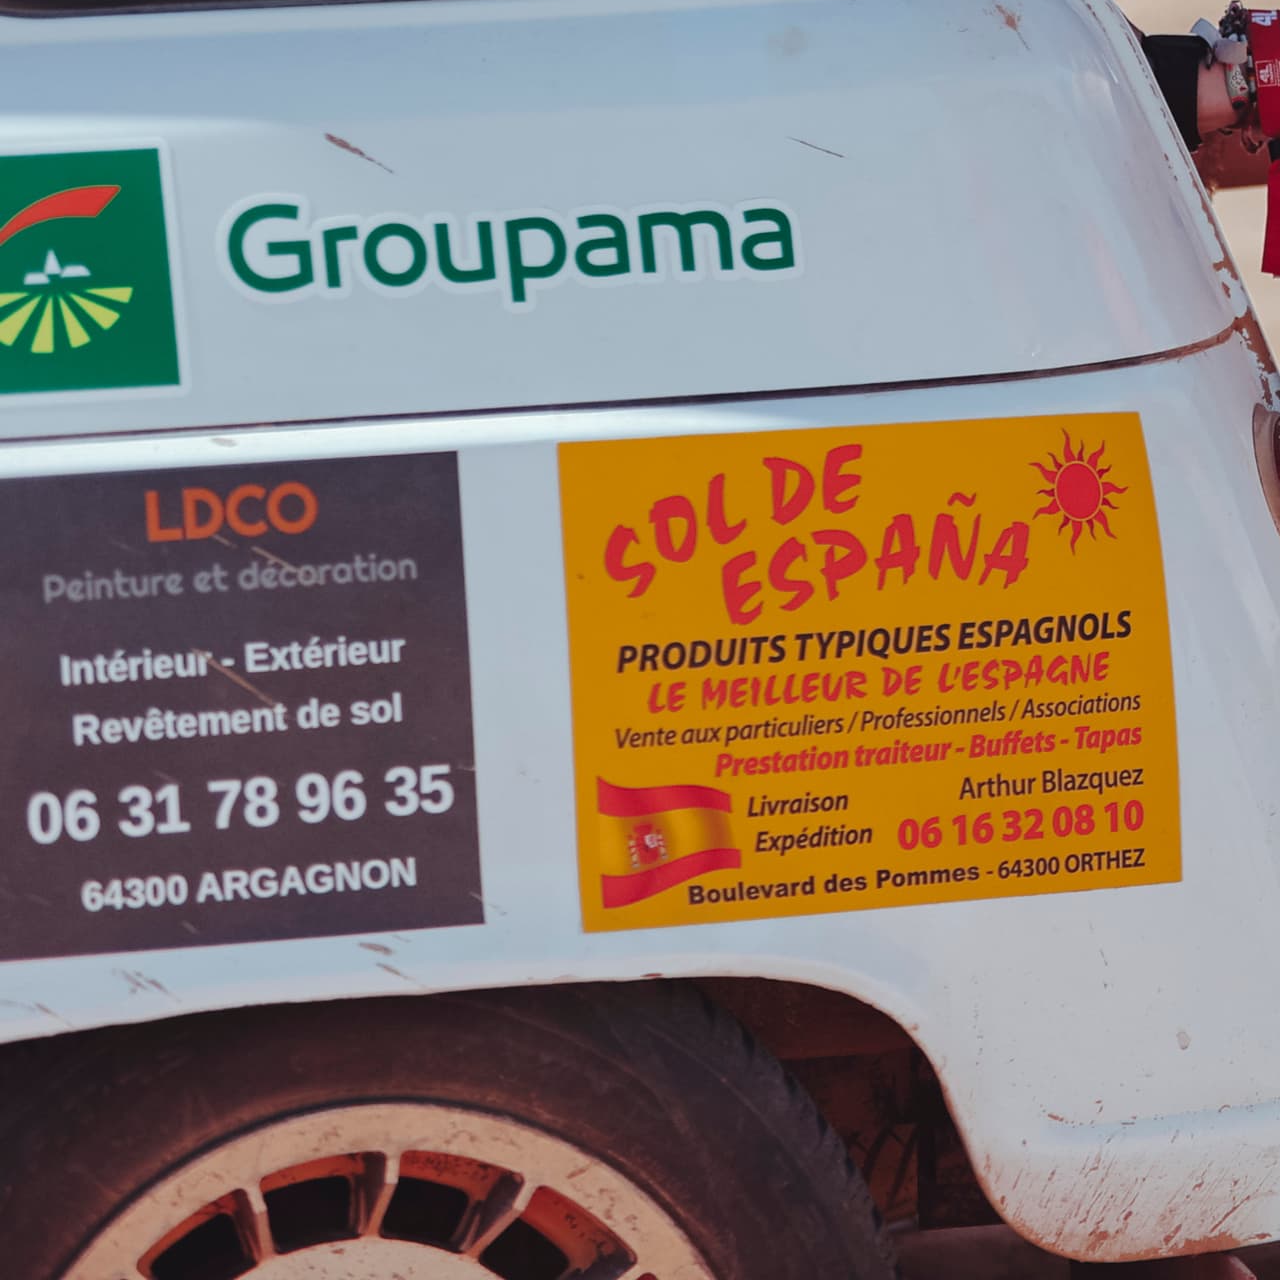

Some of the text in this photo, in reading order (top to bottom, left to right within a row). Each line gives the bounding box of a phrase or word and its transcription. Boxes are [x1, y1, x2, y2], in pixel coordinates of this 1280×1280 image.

[227, 202, 796, 303] Groupama
[145, 481, 318, 542] LDCO
[605, 443, 863, 598] SOL DE
[43, 553, 419, 603] Peinture et décoration
[722, 491, 1031, 625] ESPAÑA
[60, 647, 213, 687] Intérieur
[244, 637, 406, 673] Extérieur
[616, 610, 1132, 674] PRODUITS TYPIQUES ESPAGNOLS
[647, 651, 1110, 714] LE MEILLEUR DE L'ESPAGNE
[72, 692, 403, 746] Revêtement de sol
[615, 693, 1141, 749] Vente aux particuliers / Professionnels / Associations
[714, 746, 849, 777] Prestation
[854, 739, 951, 768] traiteur
[968, 729, 1056, 759] Buffets
[1074, 725, 1142, 754] Tapas
[27, 764, 455, 845] 06 31 78 96 35
[747, 792, 849, 818] Livraison
[959, 768, 1144, 800] Arthur Blazquez
[754, 824, 873, 857] Expédition
[897, 799, 1144, 851] 06 16 32 08 10
[81, 857, 417, 912] 64300 ARGAGNON
[688, 875, 816, 905] Boulevard
[824, 873, 868, 894] des
[876, 865, 980, 889] Pommes
[998, 856, 1060, 880] 64300
[1064, 848, 1145, 874] ORTHEZ
